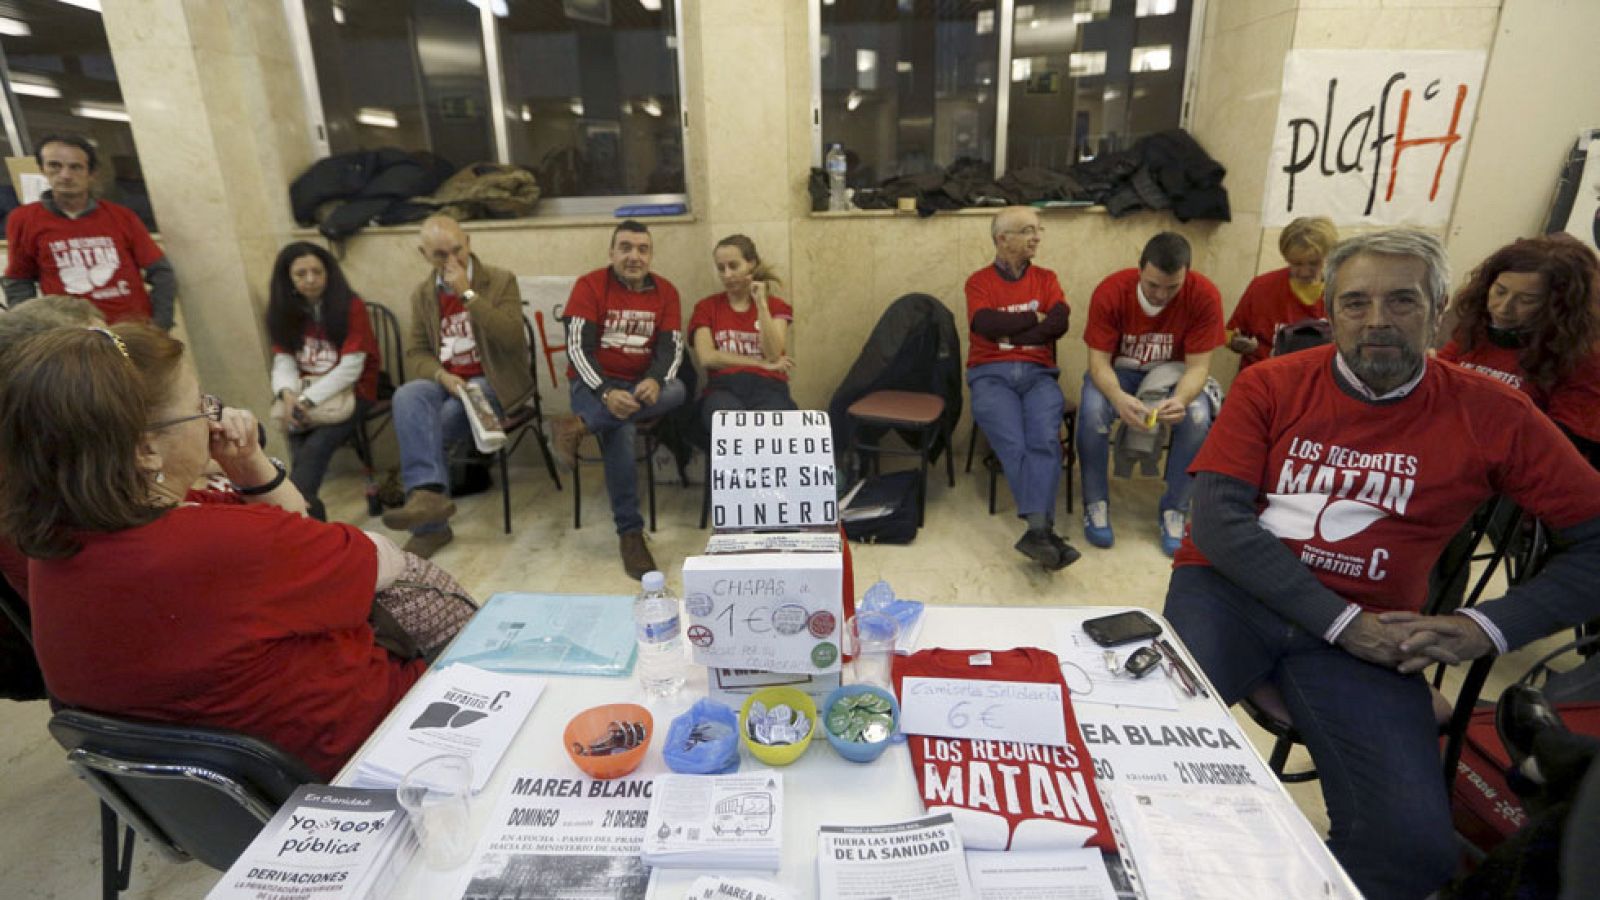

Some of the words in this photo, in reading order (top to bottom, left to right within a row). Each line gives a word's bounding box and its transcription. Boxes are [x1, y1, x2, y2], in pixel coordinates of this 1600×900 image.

[719, 412, 784, 427] TODO
[802, 412, 827, 427] NO
[716, 439, 743, 456] SE
[755, 437, 831, 455] PUEDE
[1289, 437, 1323, 462] LOS
[1326, 445, 1418, 476] RECORTES
[713, 467, 787, 490] HACER
[1276, 458, 1415, 516] MATAN
[714, 501, 835, 526] DINERO
[1300, 551, 1363, 577] HEPATITIS
[1367, 548, 1389, 581] C
[712, 578, 785, 597] CHAPAS
[1122, 725, 1242, 749] BLANCA
[923, 738, 963, 762] LOS
[972, 740, 1080, 768] RECORTES
[511, 777, 583, 798] MAREA
[588, 780, 654, 798] BLANC
[923, 761, 1098, 822] MATAN
[507, 808, 560, 826] DOMINGO
[613, 809, 649, 828] DICIEMB
[278, 836, 361, 857] pública
[834, 837, 865, 847] FUERA
[868, 837, 888, 847] LAS
[889, 830, 946, 844] EMPRESAS
[835, 848, 855, 860] DE
[858, 848, 878, 860] LA
[880, 839, 950, 860] SANIDAD
[247, 868, 349, 884] DERIVACIONES
